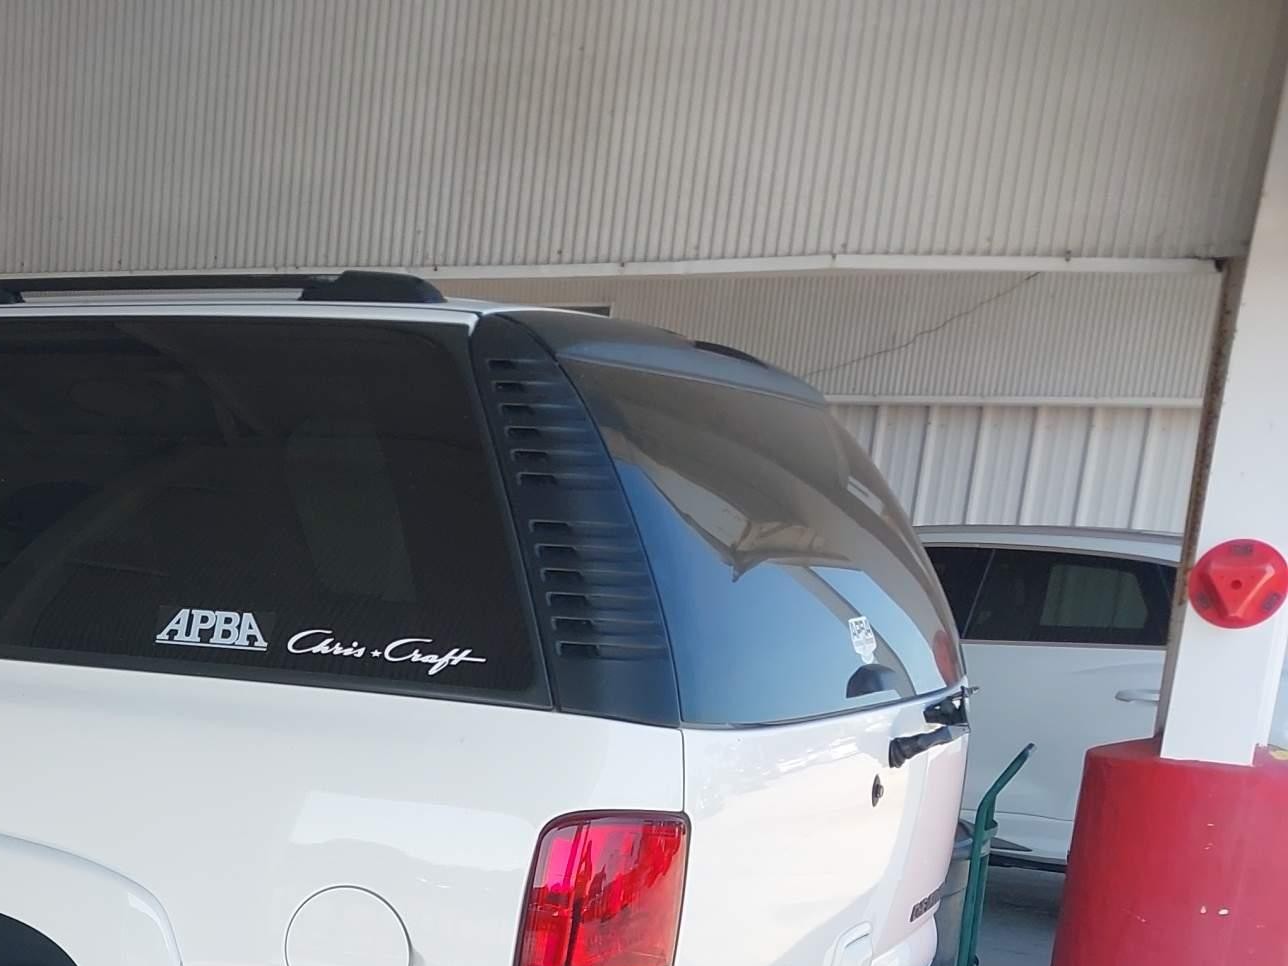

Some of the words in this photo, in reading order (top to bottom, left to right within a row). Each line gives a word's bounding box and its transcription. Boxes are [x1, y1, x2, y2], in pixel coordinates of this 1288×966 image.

[155, 608, 269, 650] APBA
[287, 628, 366, 658] Chris
[383, 637, 487, 676] Craft
